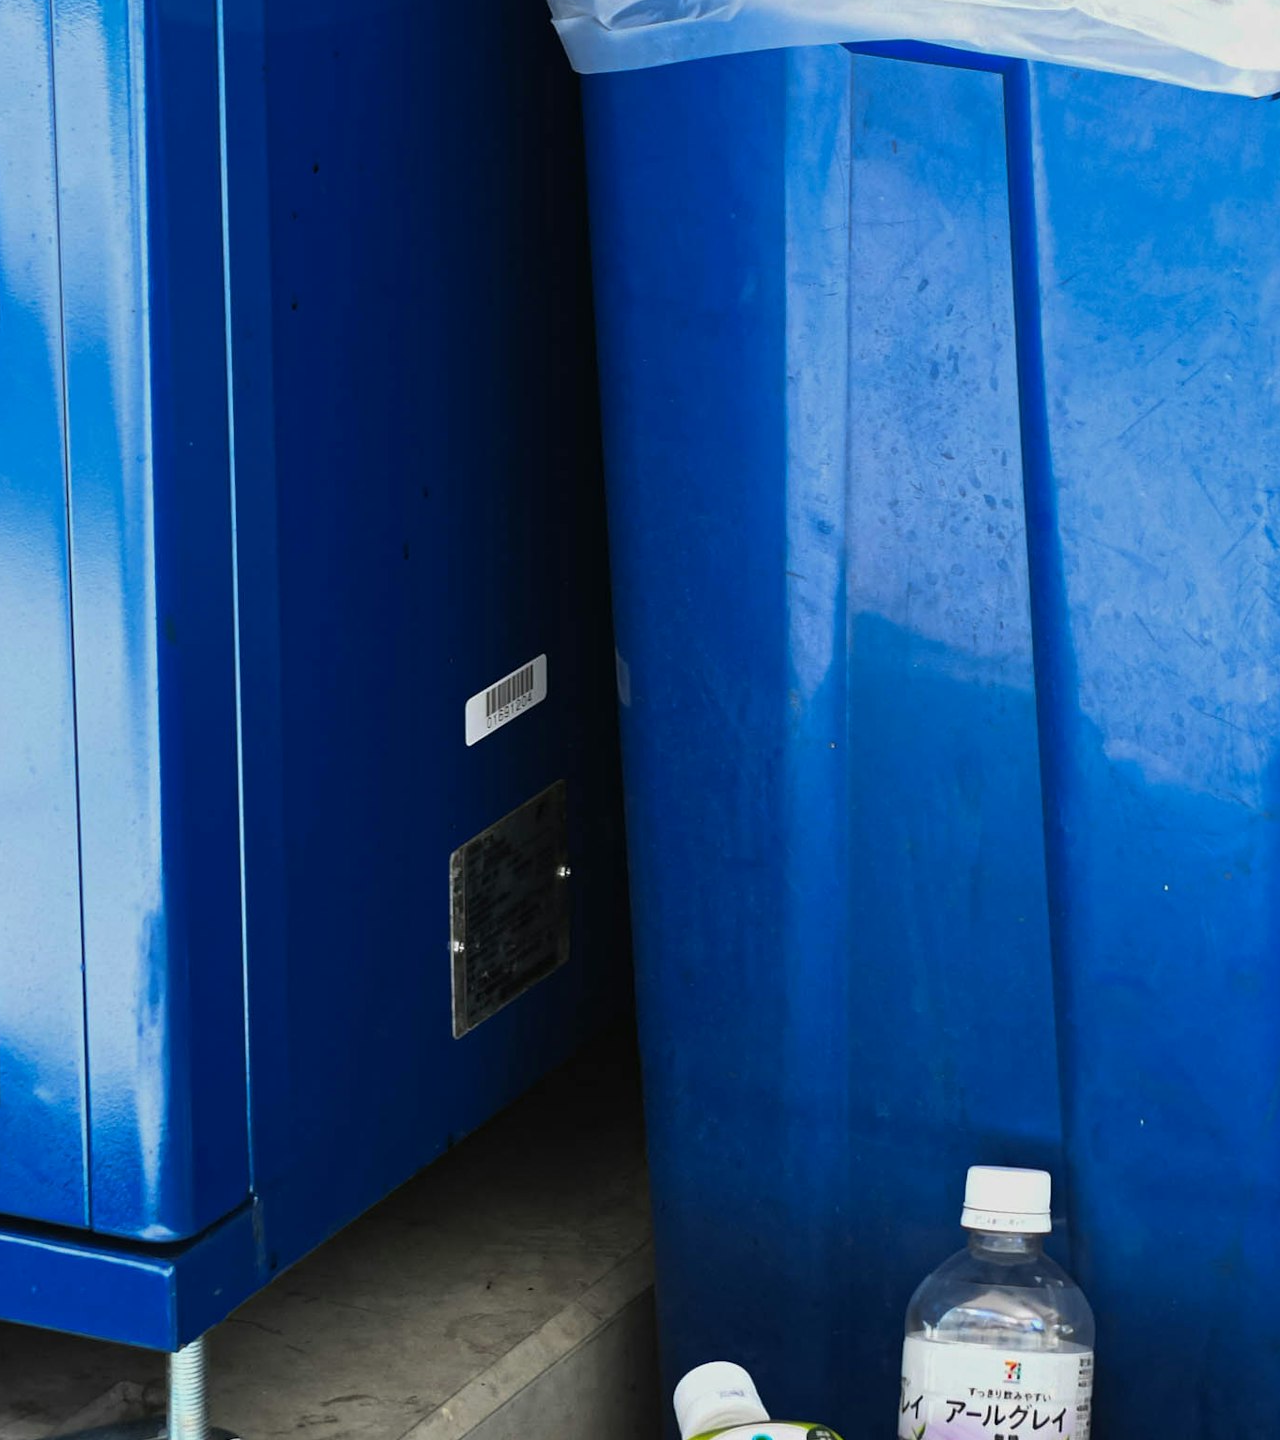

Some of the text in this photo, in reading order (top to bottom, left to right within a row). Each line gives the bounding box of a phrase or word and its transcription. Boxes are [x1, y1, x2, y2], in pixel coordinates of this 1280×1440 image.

[945, 1399, 1067, 1433] アールグレイ
